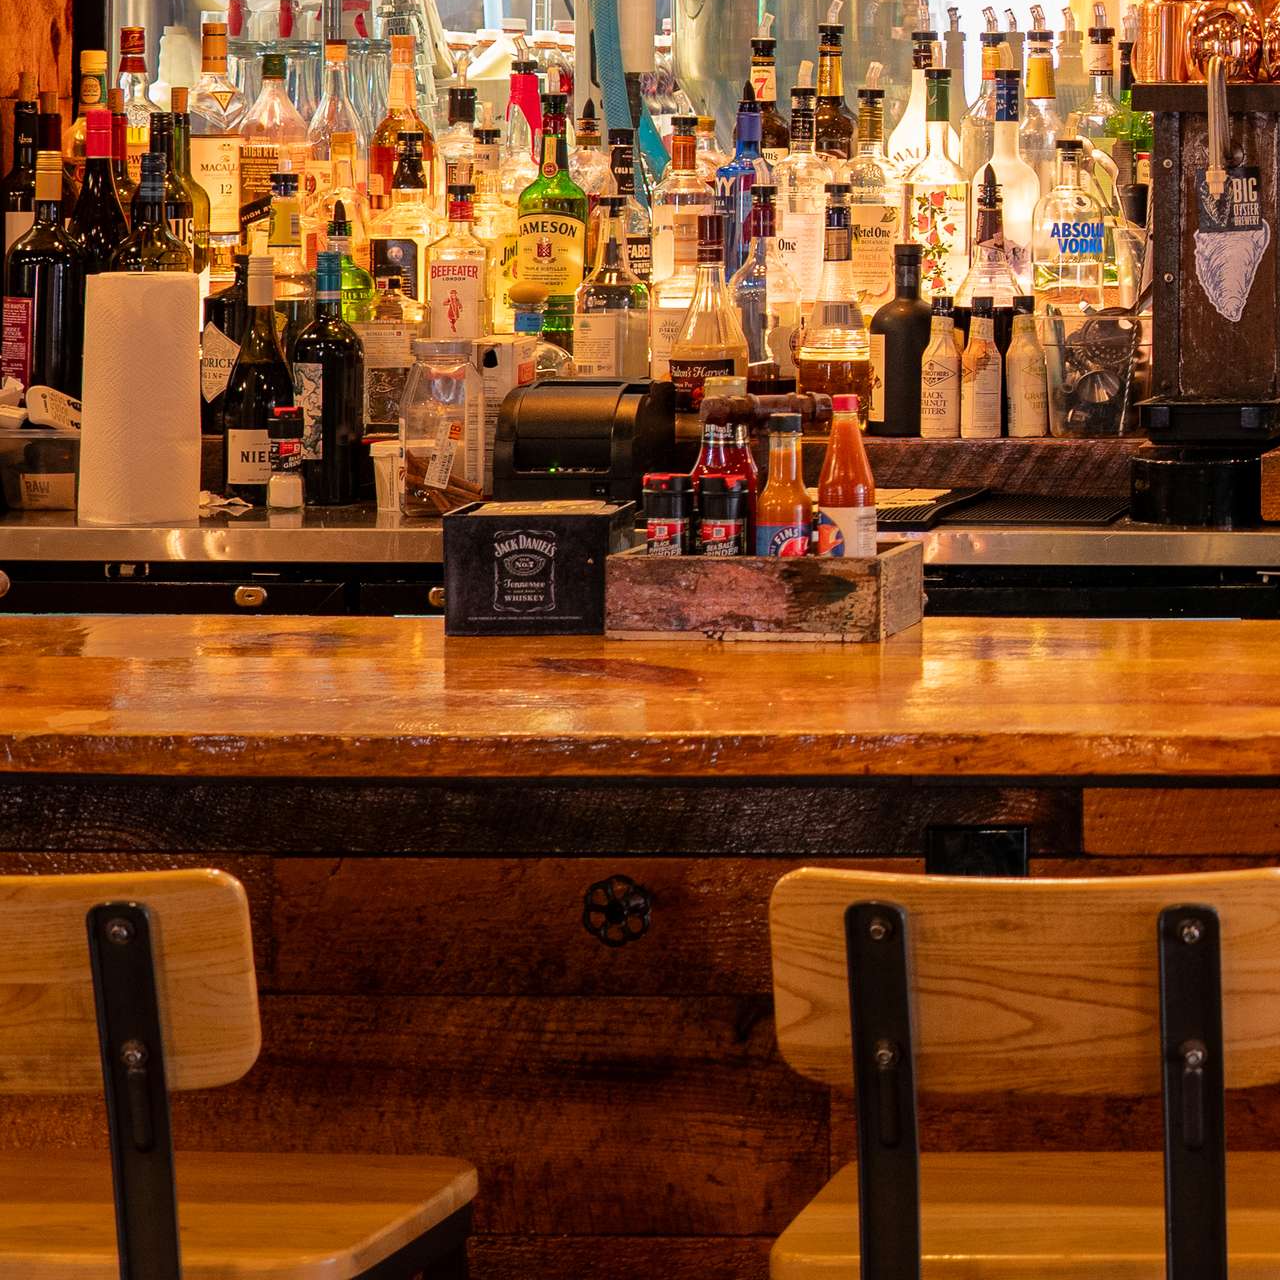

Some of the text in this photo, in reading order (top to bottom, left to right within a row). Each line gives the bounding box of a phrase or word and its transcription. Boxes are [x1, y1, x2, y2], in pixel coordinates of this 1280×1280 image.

[754, 78, 768, 99] 7
[243, 147, 261, 157] HIGH
[201, 163, 236, 172] MACALL
[220, 184, 232, 194] 12
[1232, 178, 1257, 202] BIG
[242, 209, 261, 221] HIGH
[1233, 202, 1259, 216] OYSTER
[1234, 216, 1259, 226] BREWERY
[519, 221, 577, 237] JAMESON
[875, 226, 890, 238] One
[1051, 223, 1104, 238] ABSOLU
[778, 238, 796, 251] One
[627, 245, 650, 258] FABE
[432, 265, 478, 279] BEEFEATER
[693, 366, 729, 378] Harvest
[921, 392, 944, 400] LACK
[241, 451, 272, 463] NIE
[25, 480, 50, 493] RAW
[774, 527, 800, 545] FINS
[494, 534, 558, 558] JACK DANIEL'S
[707, 543, 717, 551] SEA
[504, 579, 545, 589] Tennessee
[504, 594, 545, 602] WHISKEY
